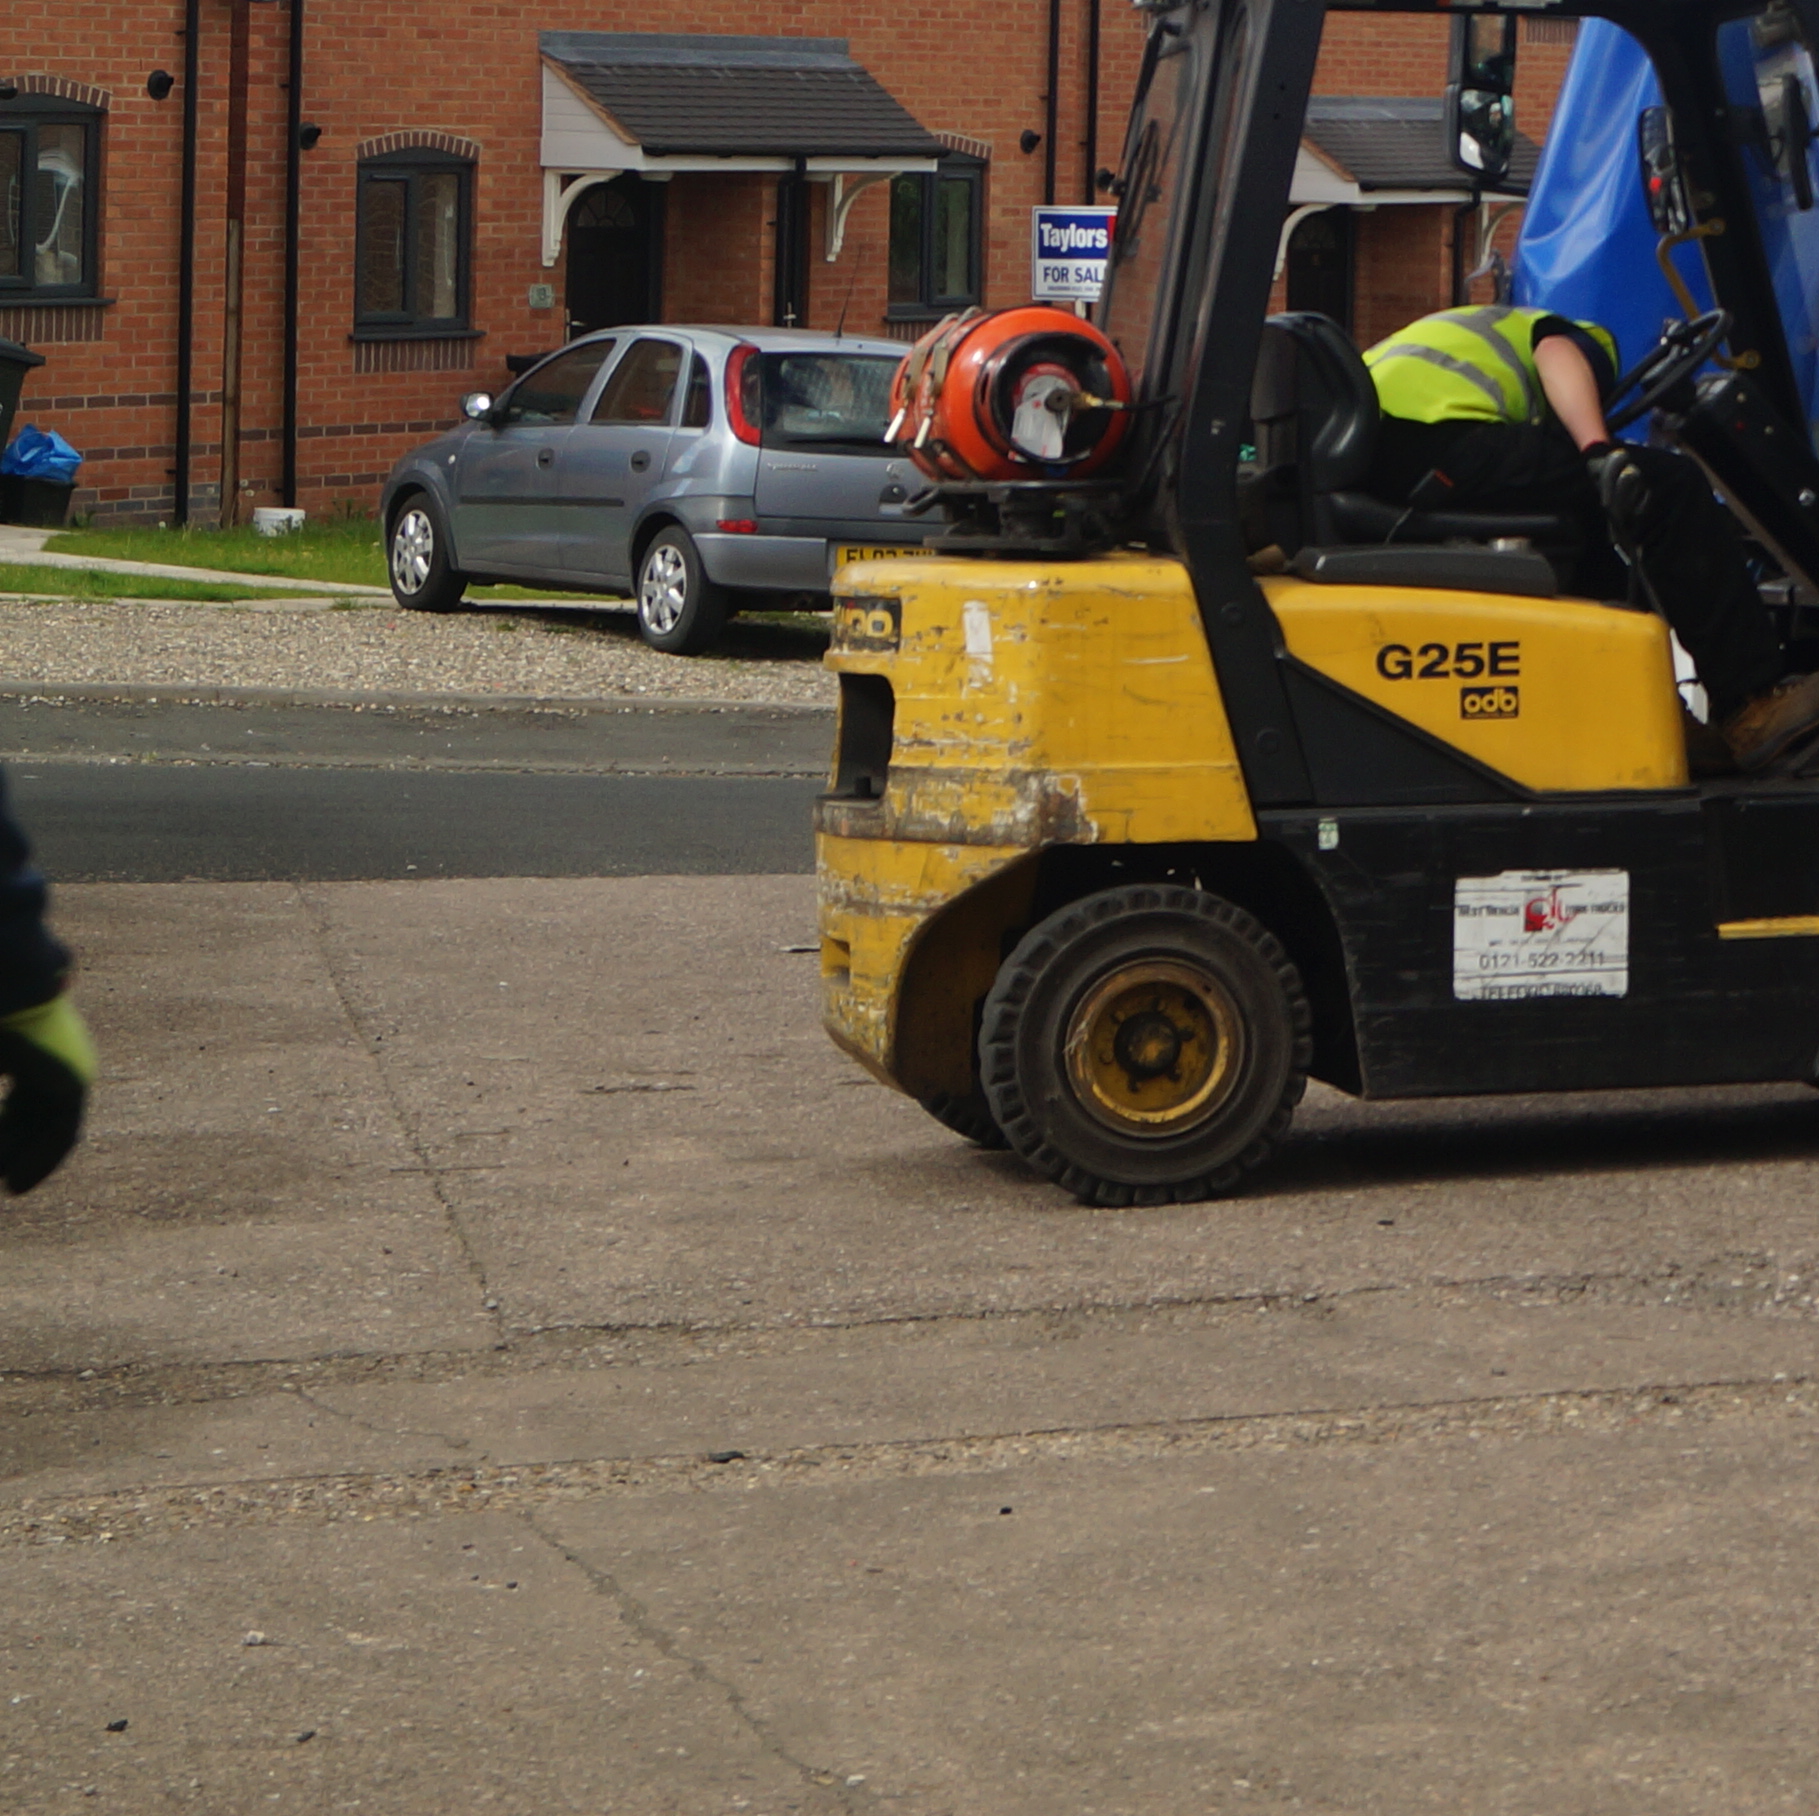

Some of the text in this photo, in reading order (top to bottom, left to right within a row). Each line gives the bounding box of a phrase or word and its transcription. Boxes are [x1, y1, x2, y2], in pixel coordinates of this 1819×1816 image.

[1040, 222, 1108, 252] Taylors
[1043, 266, 1104, 284] FOR SAL
[1376, 641, 1521, 680] G25E
